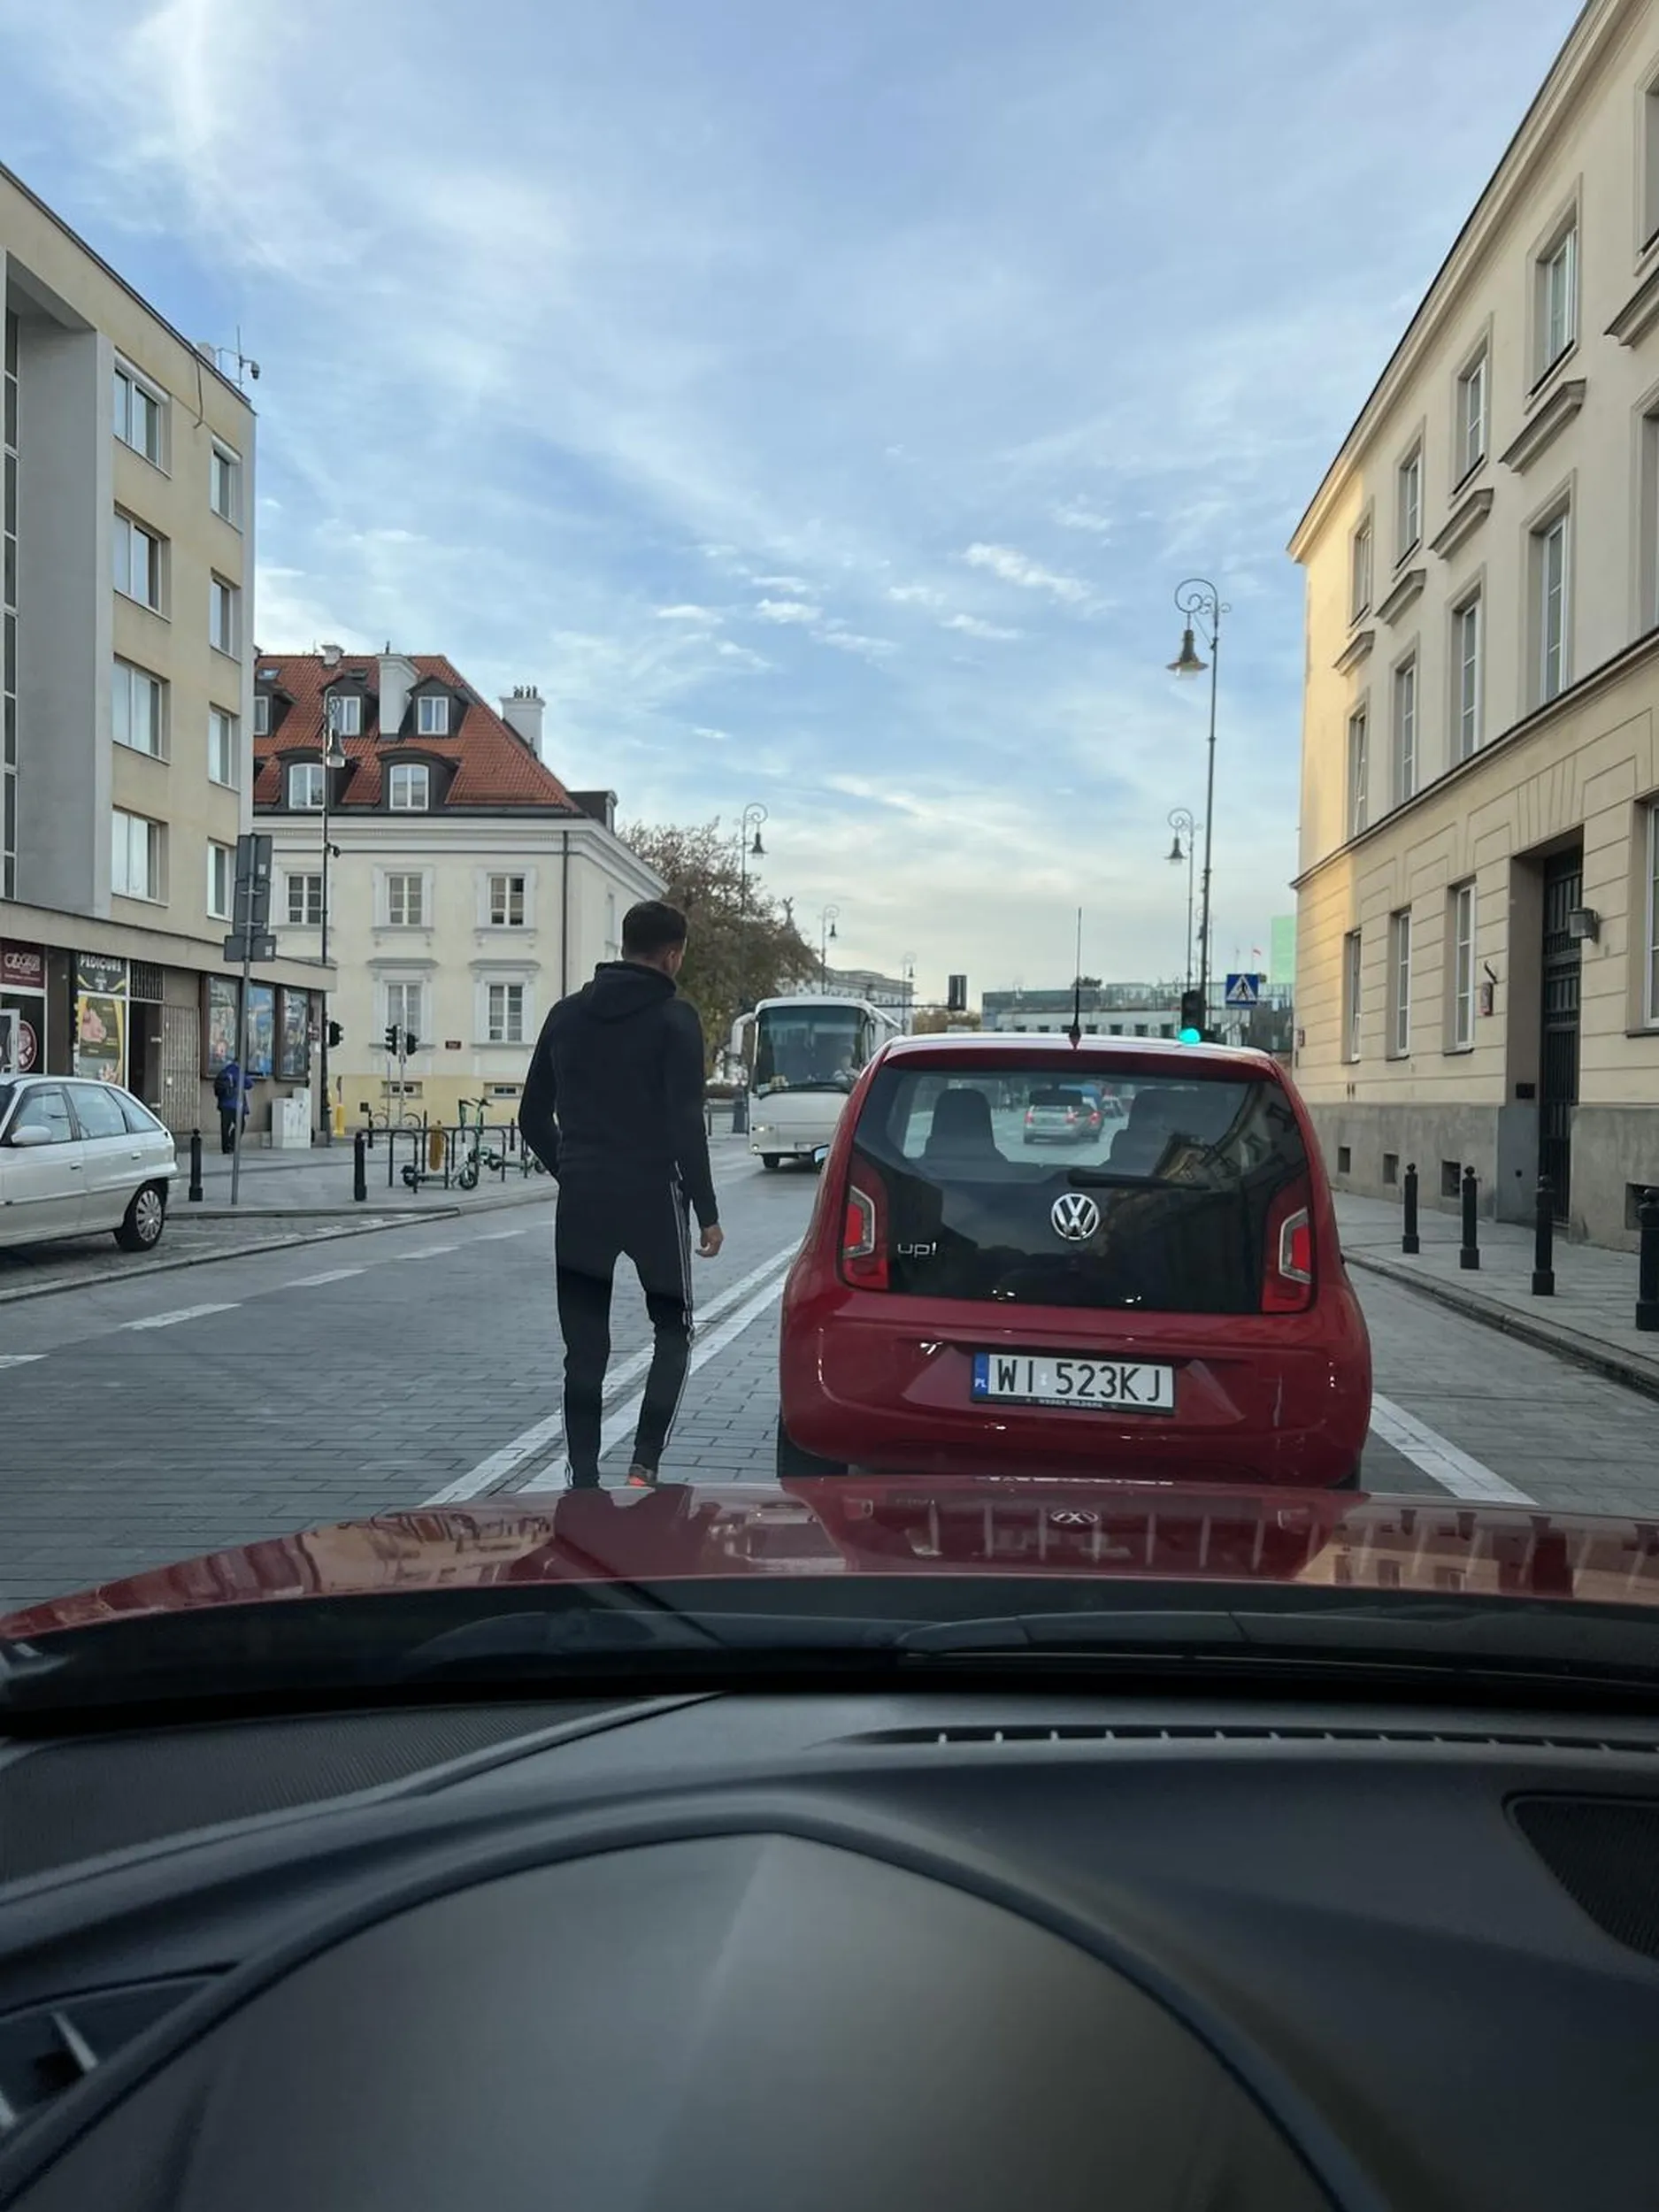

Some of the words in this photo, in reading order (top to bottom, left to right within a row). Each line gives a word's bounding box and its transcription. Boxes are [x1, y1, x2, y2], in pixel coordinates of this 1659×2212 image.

[897, 1241, 937, 1257] up!
[975, 1378, 987, 1388] PL
[997, 1359, 1034, 1393] WI
[1056, 1362, 1161, 1402] 523KJ
